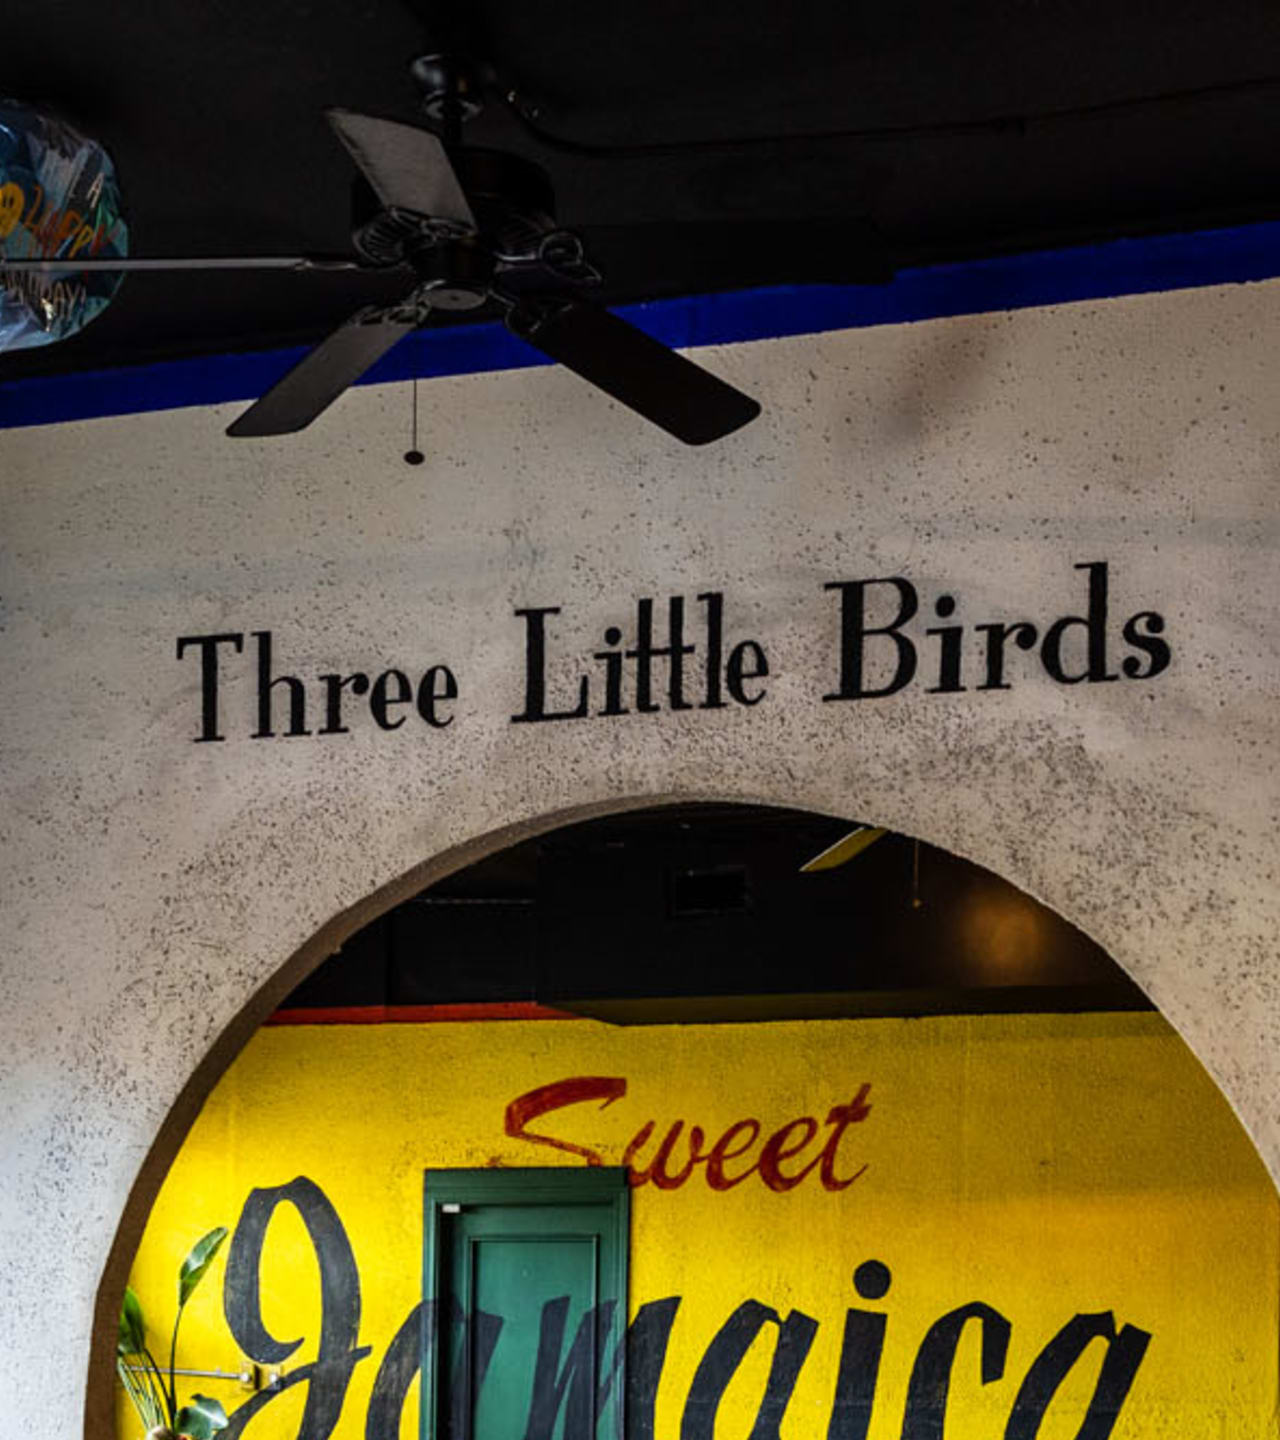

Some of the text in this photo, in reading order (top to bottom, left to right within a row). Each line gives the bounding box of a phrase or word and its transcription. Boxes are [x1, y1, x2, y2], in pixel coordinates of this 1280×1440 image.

[177, 562, 1172, 743] Three Little Birds
[502, 1075, 873, 1193] Sweet
